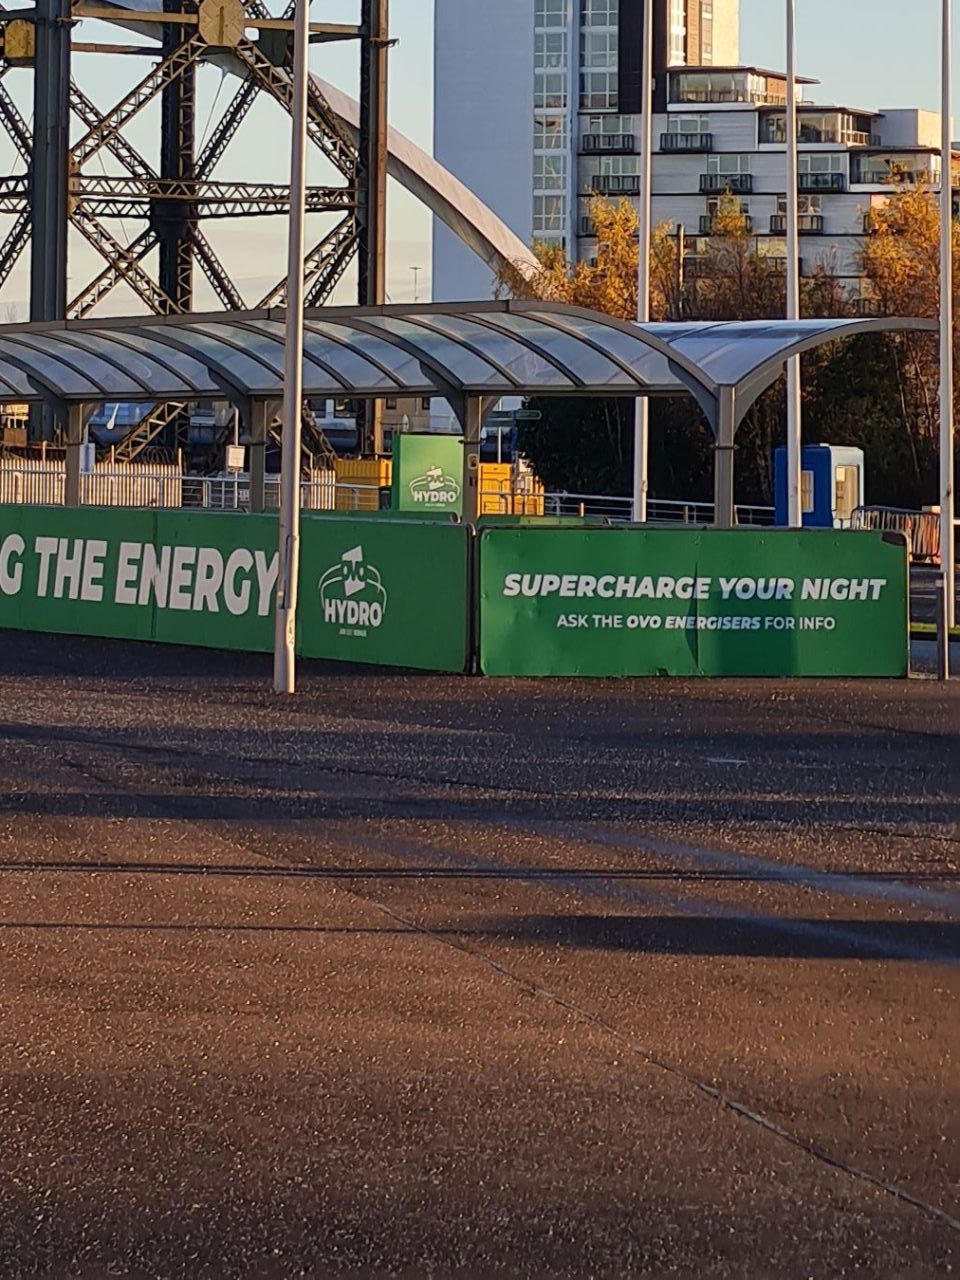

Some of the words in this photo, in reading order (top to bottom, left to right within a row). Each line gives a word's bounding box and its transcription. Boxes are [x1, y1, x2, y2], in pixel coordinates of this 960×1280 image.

[414, 491, 456, 502] HYDRO
[34, 536, 108, 602] THE
[114, 542, 280, 617] ENERGY
[503, 574, 711, 600] SUPERCHARGE
[719, 577, 794, 600] YOUR
[801, 578, 887, 600] NIGHT
[324, 599, 383, 627] HYDRO
[557, 614, 589, 628] ASK
[592, 615, 623, 628] THE
[626, 615, 662, 629] OVO
[665, 616, 761, 630] ENERGISERS
[765, 617, 795, 630] FOR
[799, 617, 836, 630] INFO
